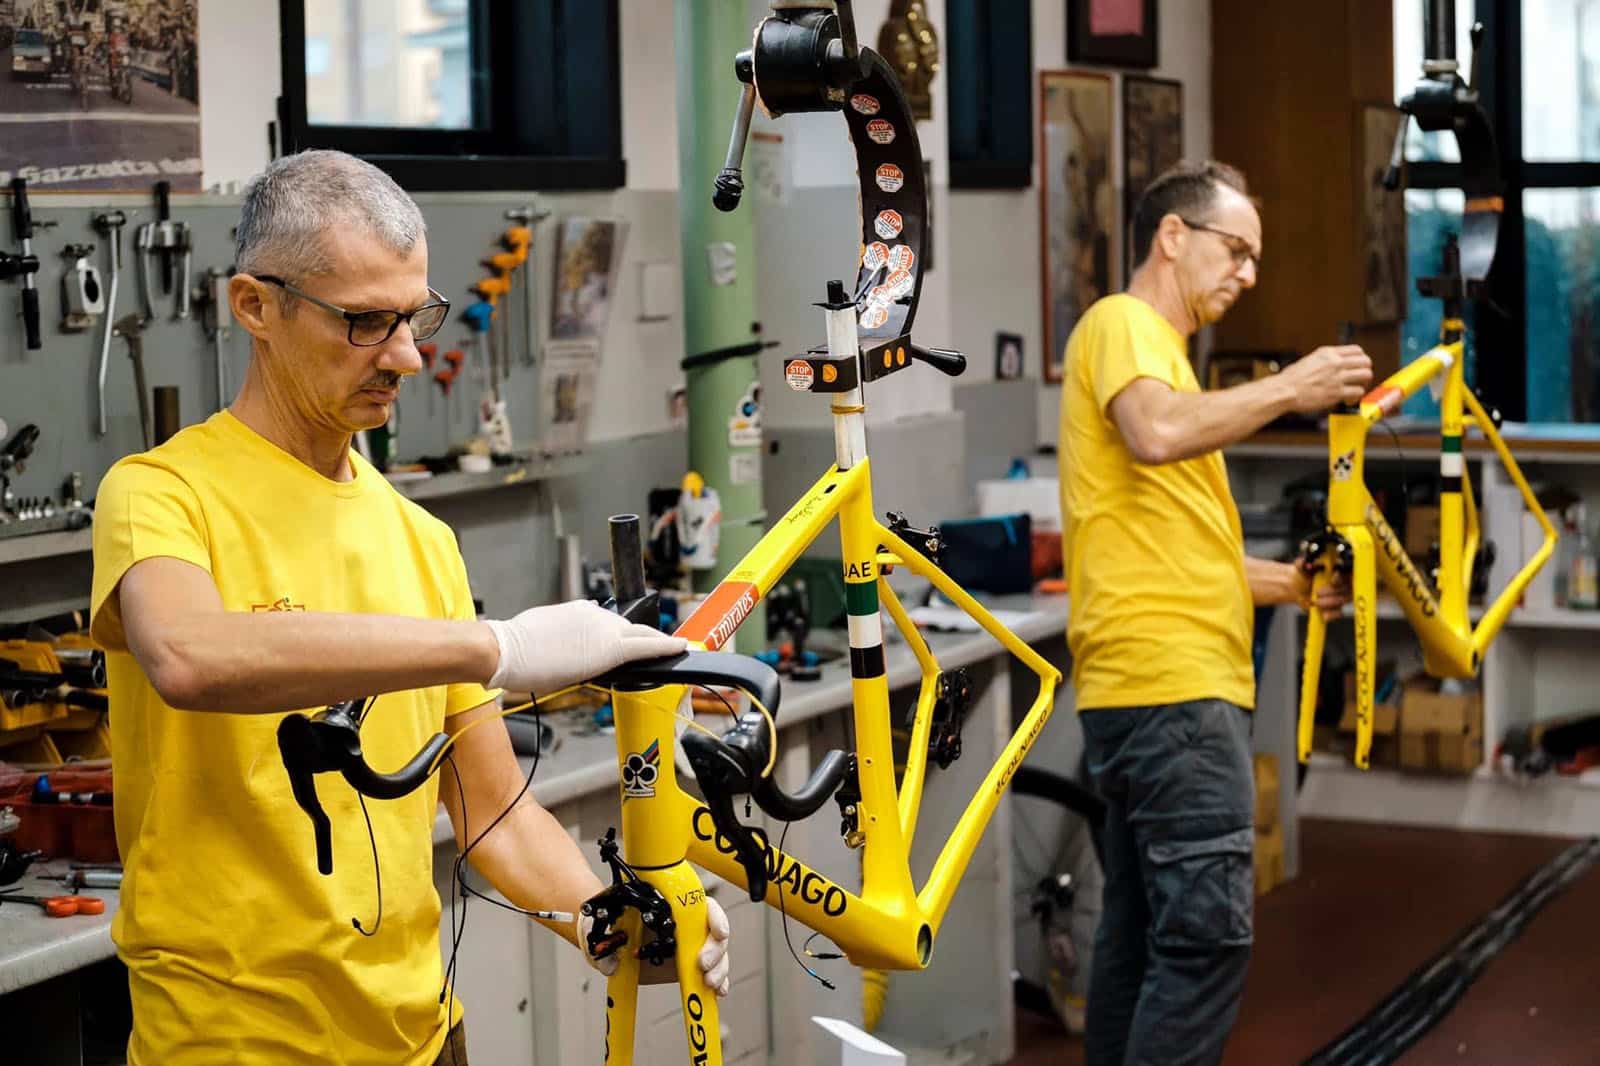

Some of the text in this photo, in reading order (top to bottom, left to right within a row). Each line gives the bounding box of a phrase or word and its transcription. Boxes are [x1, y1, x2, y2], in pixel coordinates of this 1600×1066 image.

[870, 123, 889, 131] STOP
[18, 160, 159, 185] Gazzetta
[881, 168, 900, 177] STOP
[884, 213, 900, 228] STOP
[791, 366, 810, 374] STOP
[711, 592, 754, 649] Emirates
